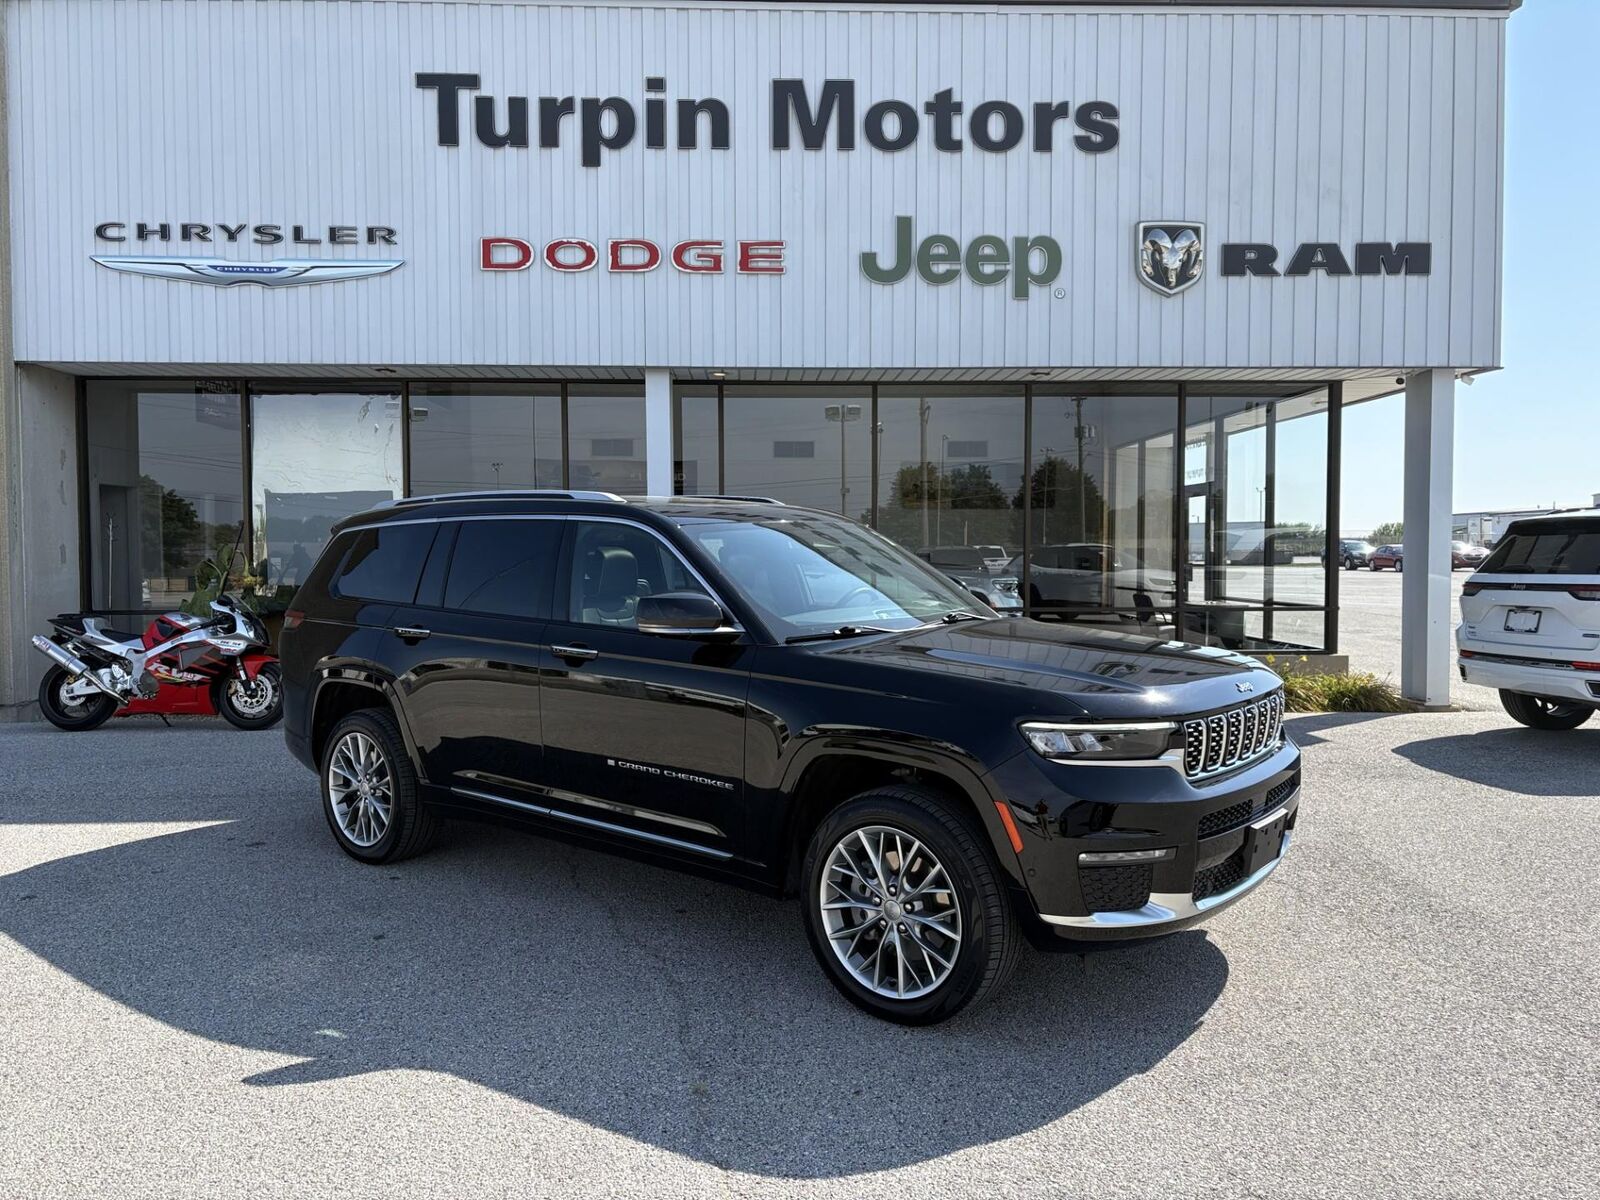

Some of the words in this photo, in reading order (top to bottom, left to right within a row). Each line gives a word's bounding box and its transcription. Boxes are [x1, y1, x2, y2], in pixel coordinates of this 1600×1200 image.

[415, 73, 730, 166] Turpin
[772, 80, 1119, 153] Motors
[95, 223, 397, 245] CHRYSLER
[480, 237, 787, 274] DODGE
[861, 215, 1062, 300] Jeep
[1221, 242, 1431, 276] RAM
[618, 760, 660, 775] GRAND
[663, 769, 735, 791] CHEROKEE
